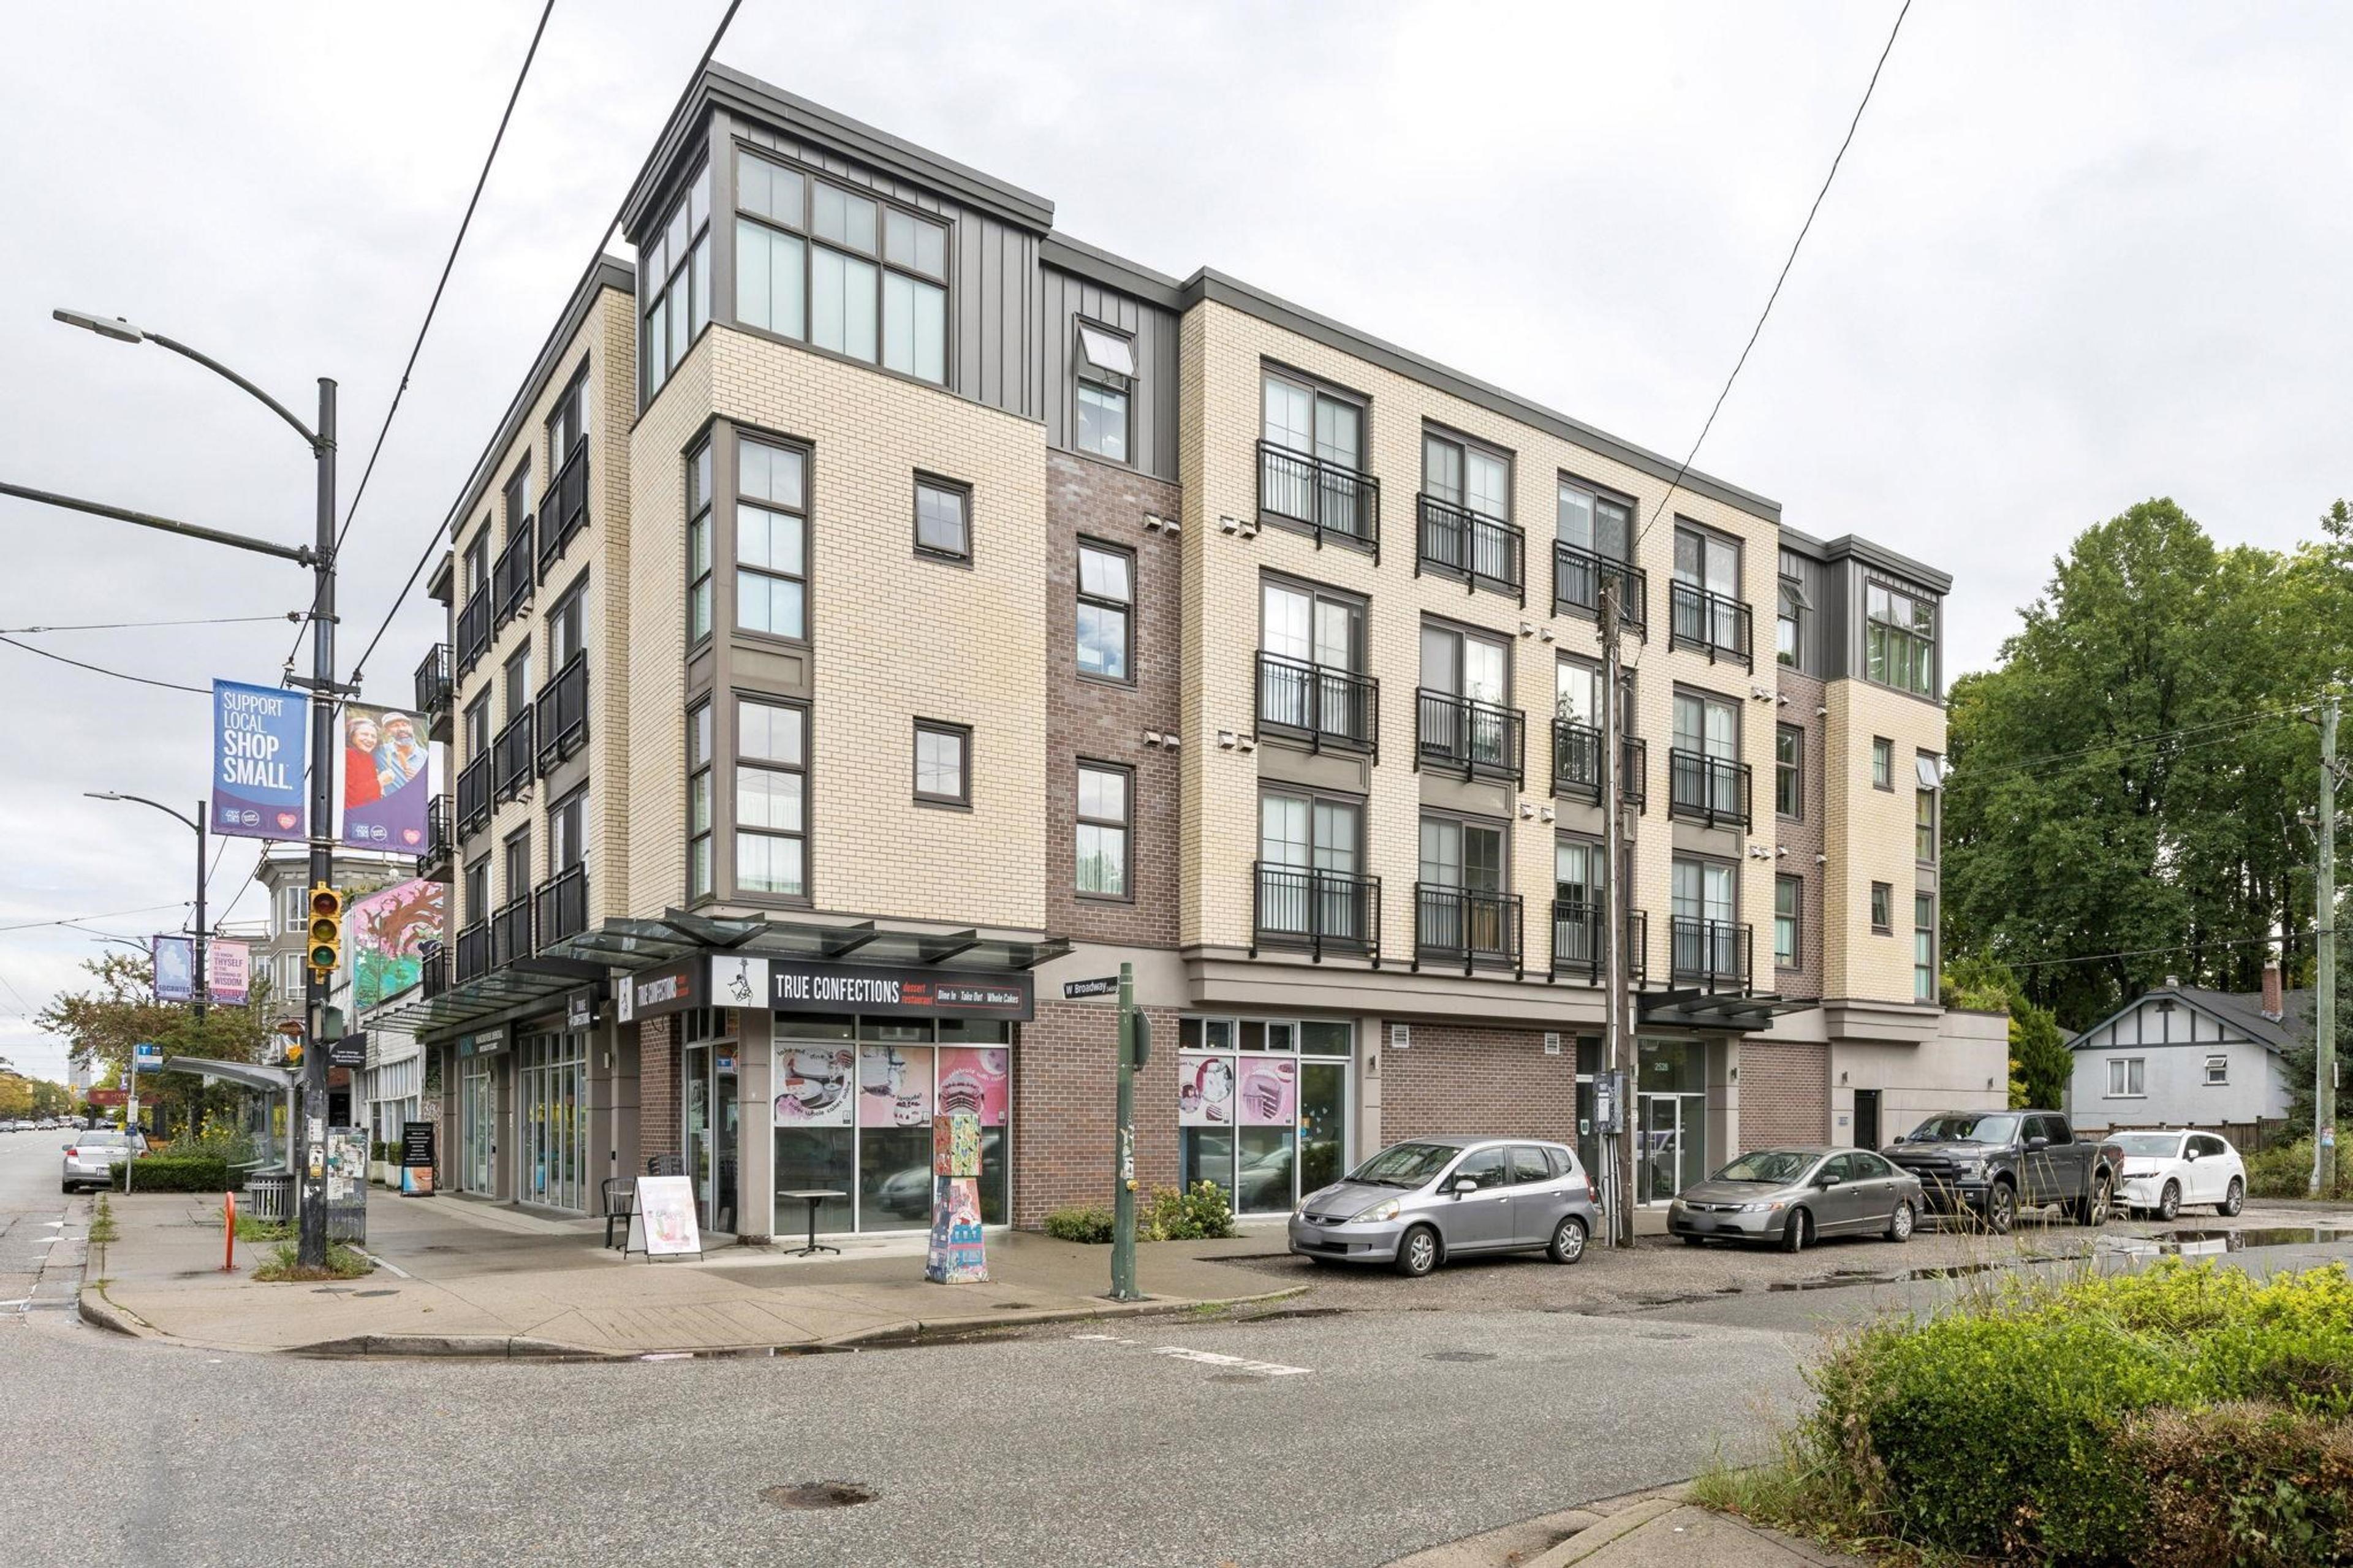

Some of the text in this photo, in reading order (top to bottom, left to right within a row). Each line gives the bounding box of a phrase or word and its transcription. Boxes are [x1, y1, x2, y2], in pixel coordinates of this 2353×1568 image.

[224, 691, 283, 717] SUPPORT
[224, 710, 267, 733] LOCAL
[224, 729, 279, 760] SHOP
[214, 957, 243, 968] THYSELF
[775, 974, 900, 1004] TRUE CONFECTIONS
[902, 982, 926, 993] dessert
[1066, 984, 1073, 994] W
[1074, 982, 1107, 993] Broadway
[901, 995, 933, 1006] restaurant
[938, 990, 1020, 1004] Dine In Take Out Whole Cakes
[827, 1100, 843, 1113] cakes
